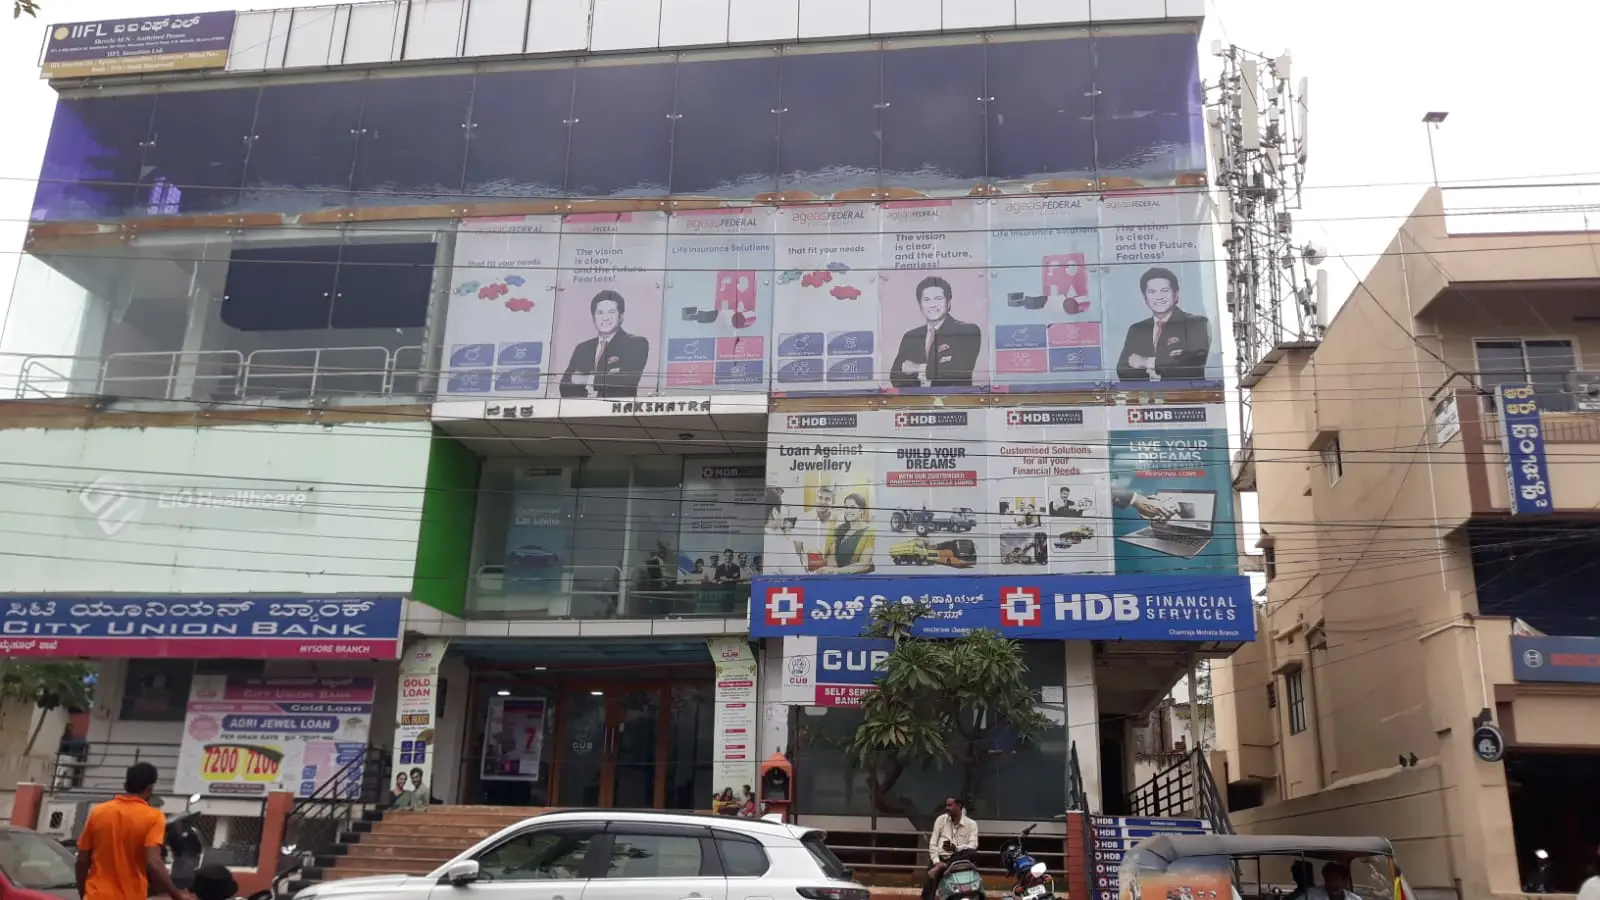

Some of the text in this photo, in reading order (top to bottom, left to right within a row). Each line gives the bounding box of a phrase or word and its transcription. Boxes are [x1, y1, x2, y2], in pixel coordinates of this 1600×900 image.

[72, 24, 107, 39] IIFL
[916, 233, 946, 241] vision
[576, 247, 623, 256] The vision
[689, 245, 729, 254] Insurance
[731, 244, 770, 252] Solutions
[788, 245, 865, 256] that fit your needs
[1116, 243, 1136, 251] and
[1139, 242, 1157, 250] the
[575, 257, 583, 265] is
[895, 252, 915, 260] and
[917, 252, 934, 260] the
[1116, 252, 1165, 261] Fearless!
[895, 261, 940, 269] Fearless!
[573, 275, 616, 284] Fearless!
[910, 415, 937, 425] HDB
[1023, 413, 1050, 422] HDB
[1143, 411, 1172, 420] HDB
[801, 417, 827, 428] HDB
[779, 443, 863, 457] Loan Against
[1000, 445, 1092, 455] Customised Solutions
[1129, 440, 1208, 451] LIVE YOUR
[897, 447, 966, 459] BUILD YOUR
[1138, 451, 1201, 462] DREAMS
[789, 459, 852, 472] Jewellery
[906, 458, 956, 470] DREAMS
[1023, 456, 1069, 467] for all your
[1012, 466, 1081, 476] Financial Needs
[196, 490, 307, 509] Healthcare
[1054, 593, 1140, 621] HDB
[1146, 596, 1237, 608] FINANCIAL
[269, 601, 375, 622] ಬ್ಯಾಂಕ್
[1146, 608, 1236, 621] SERVICES
[3, 620, 367, 635] CITY UNION BANK
[299, 645, 370, 654] MYSORE BRANCH
[823, 649, 889, 672] CUB
[403, 678, 430, 687] GOLD
[403, 688, 430, 698] LOAN
[824, 688, 846, 696] SELF
[291, 704, 362, 713] Gold Loan
[259, 719, 298, 729] JEWEL
[300, 719, 331, 729] LOAN
[204, 746, 238, 773] 7200
